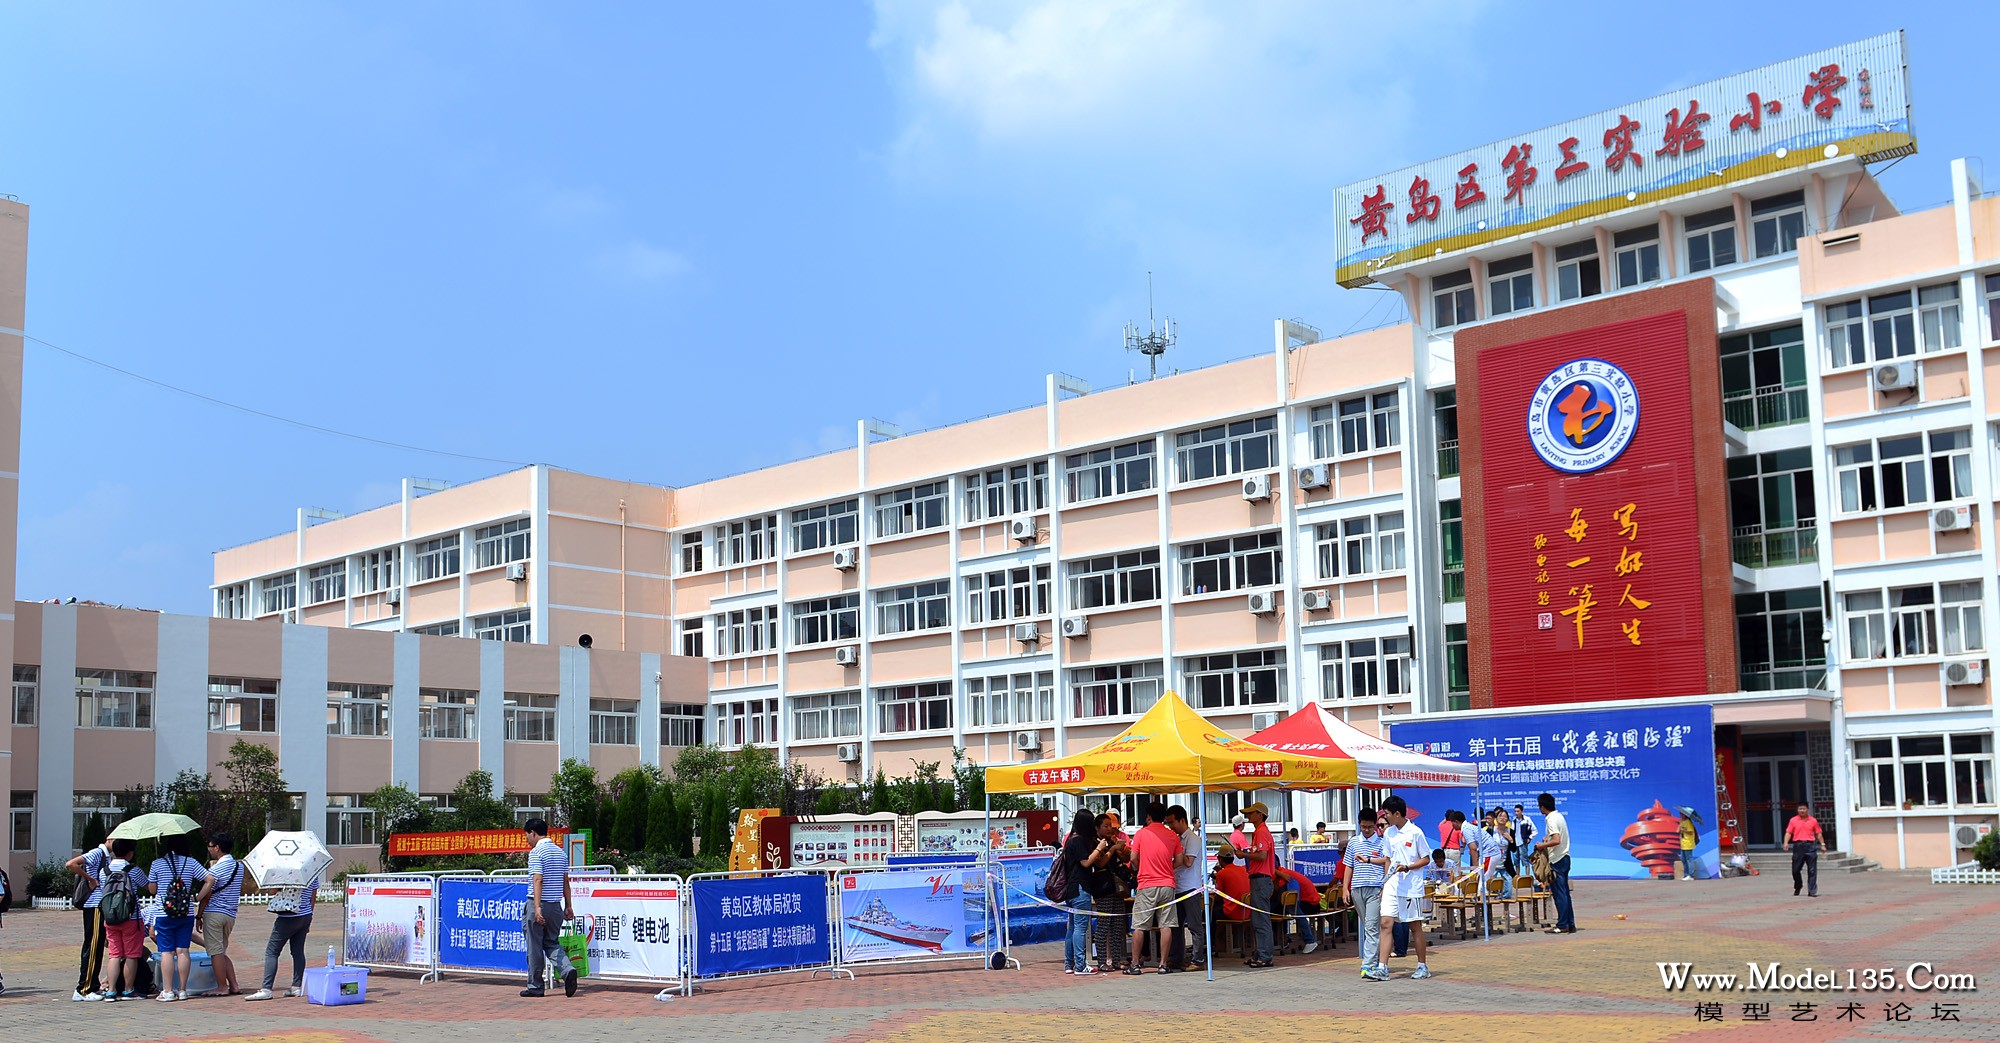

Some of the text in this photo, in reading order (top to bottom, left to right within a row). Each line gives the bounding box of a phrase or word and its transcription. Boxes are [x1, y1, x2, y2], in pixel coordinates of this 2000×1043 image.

[1350, 63, 1849, 244] 黄岛区第三实验小学
[1540, 424, 1630, 466] LANTING PRIMARY SCHOOL
[1468, 736, 1541, 757] 第十五届
[1238, 762, 1279, 777] 古龙午餐肉
[1477, 756, 1626, 772] 国青少年航海模型教育竞赛总决赛
[1029, 767, 1080, 784] 古龙午餐肉
[721, 892, 801, 919] 黄岛区教体局祝贺
[1406, 899, 1412, 909] 7
[632, 916, 670, 944] 锂电池
